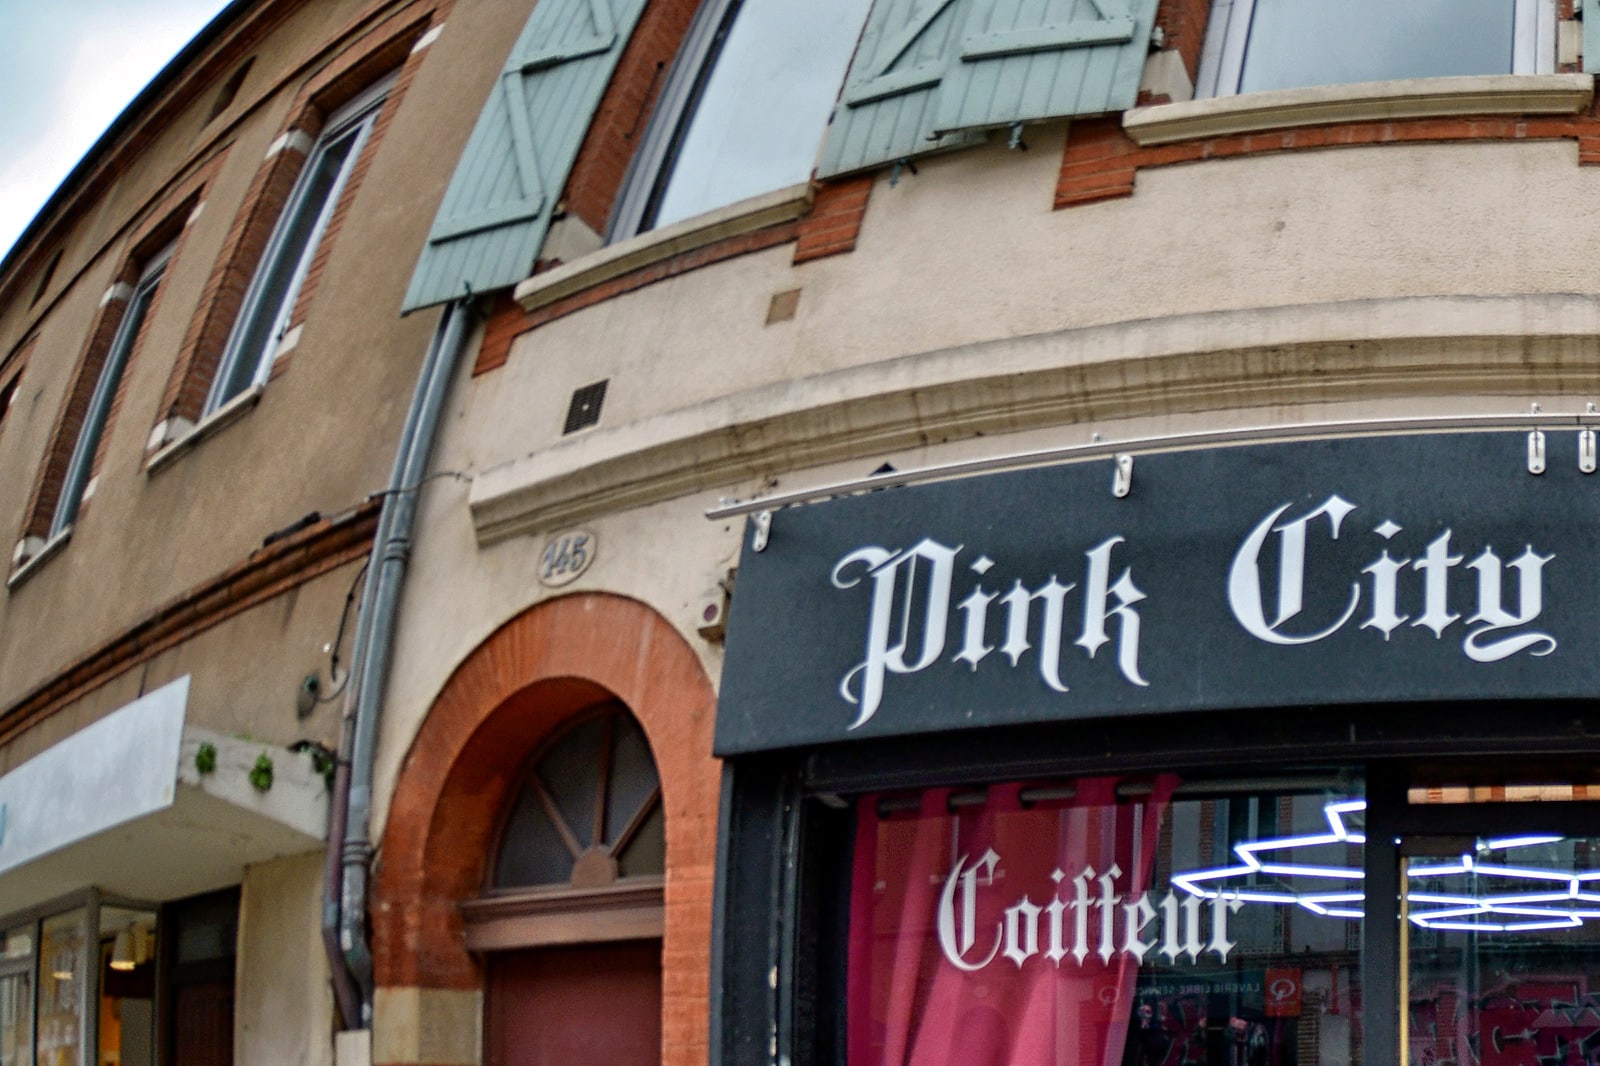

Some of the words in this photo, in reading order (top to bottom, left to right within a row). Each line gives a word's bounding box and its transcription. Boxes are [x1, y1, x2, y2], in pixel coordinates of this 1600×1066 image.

[543, 536, 590, 580] 145
[831, 535, 1150, 731] Pink
[1228, 494, 1557, 664] City
[936, 848, 1245, 972] Coiffeur
